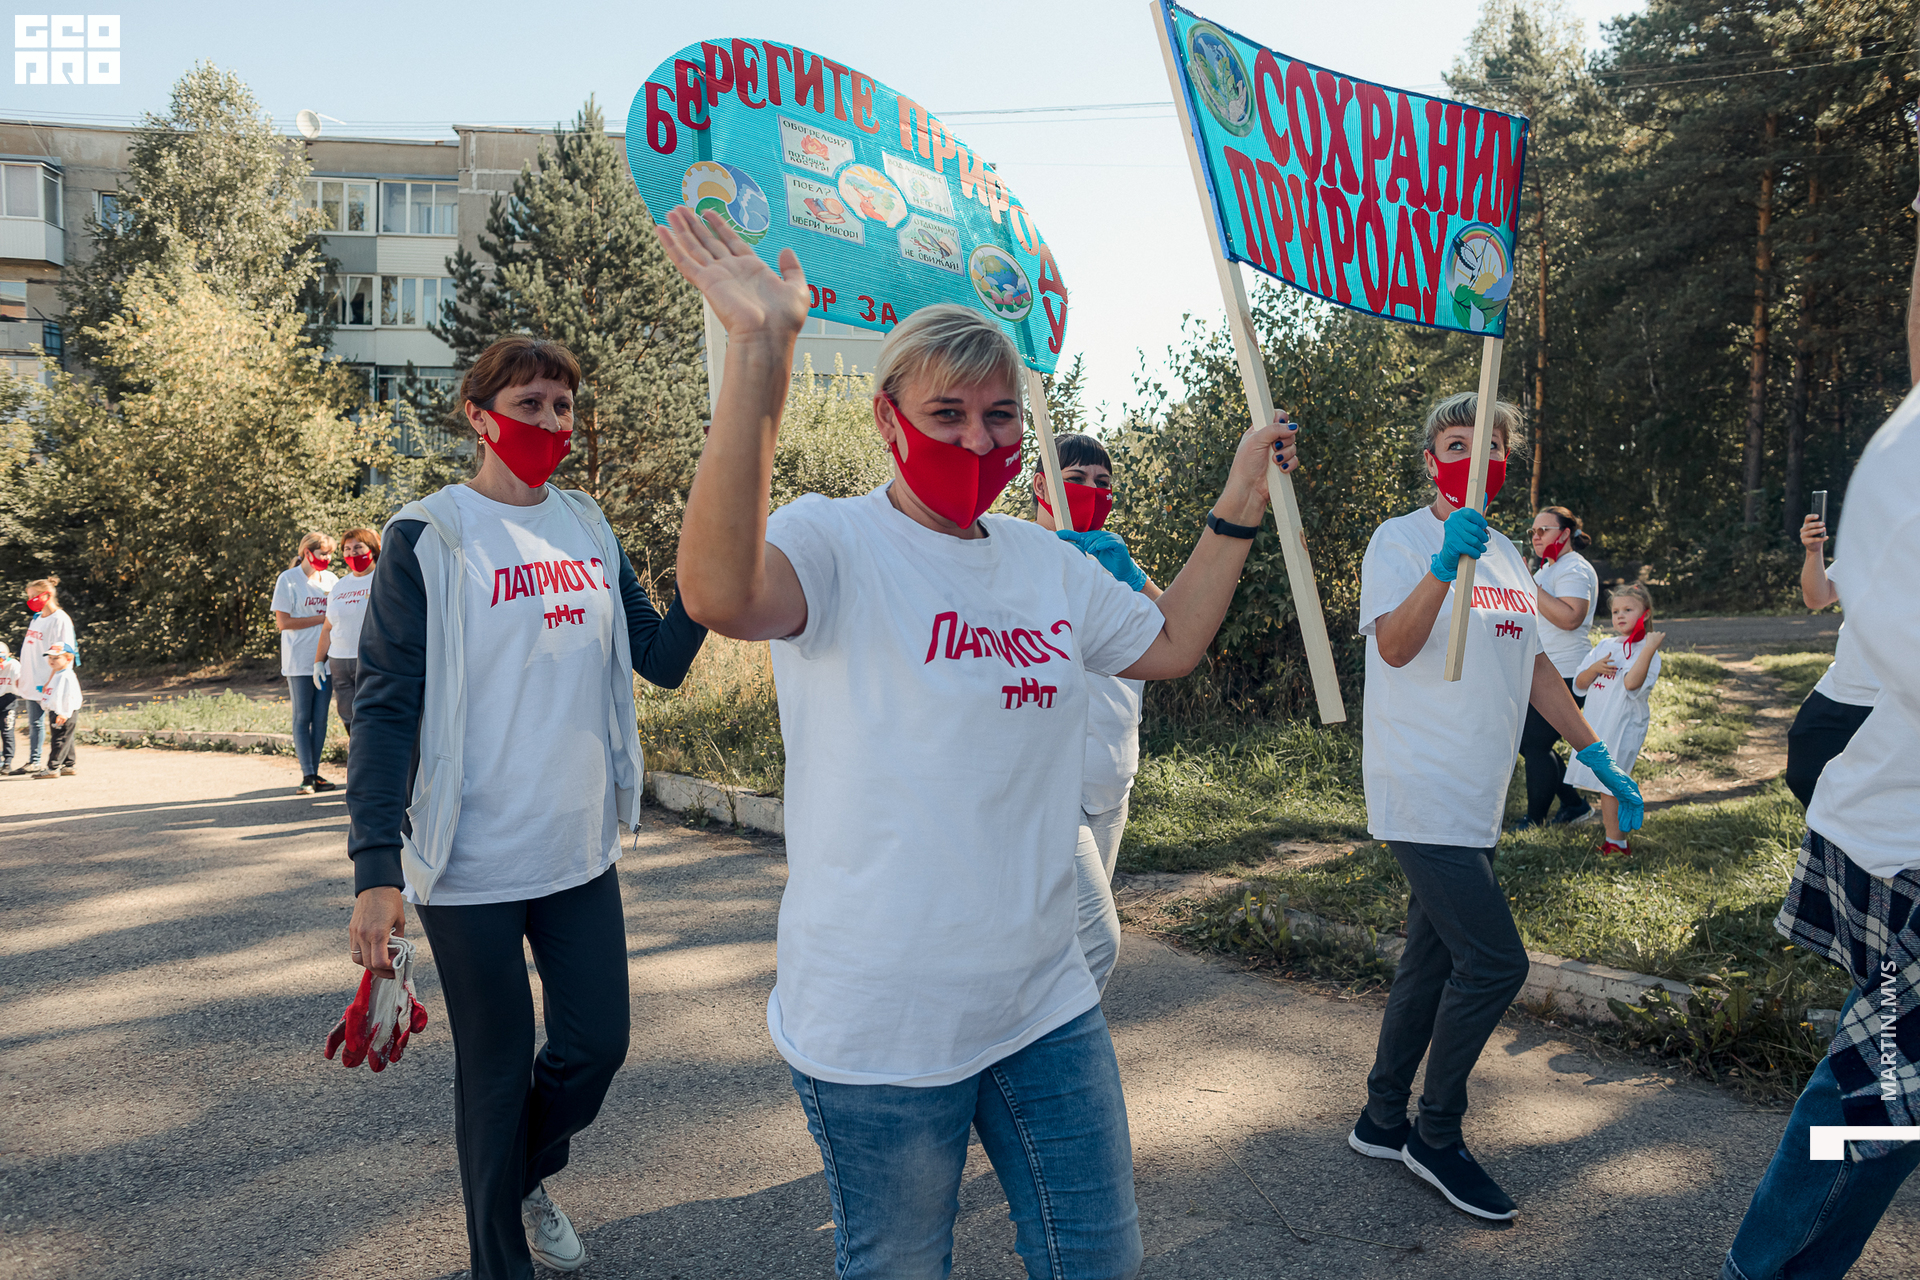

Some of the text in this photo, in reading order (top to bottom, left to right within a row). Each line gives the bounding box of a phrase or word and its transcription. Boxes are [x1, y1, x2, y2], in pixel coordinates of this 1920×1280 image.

[783, 119, 847, 148] ОБОГРЕЛСЯ?
[1254, 48, 1524, 232] СОХРАНИМ
[887, 158, 943, 184] ВОДА ДОРОЖЕ
[645, 38, 1069, 355] БЕРЕГИТЕ ПРИРОДУ
[793, 179, 831, 196] ПОЕЛ?
[912, 196, 950, 214] НЕФТИ!
[792, 215, 859, 240] УБЕРИ МУСОР!
[1224, 145, 1448, 325] ПРИРОДУ
[905, 248, 959, 271] НЕ ОБИЖАЙ!
[858, 295, 899, 326] ЗА
[490, 559, 598, 609] ПАТРИОТ
[1470, 585, 1536, 617] АТРИОТ
[543, 604, 587, 630] ТНТ
[1494, 619, 1523, 640] ТНТ
[1000, 677, 1058, 710] ТНТ
